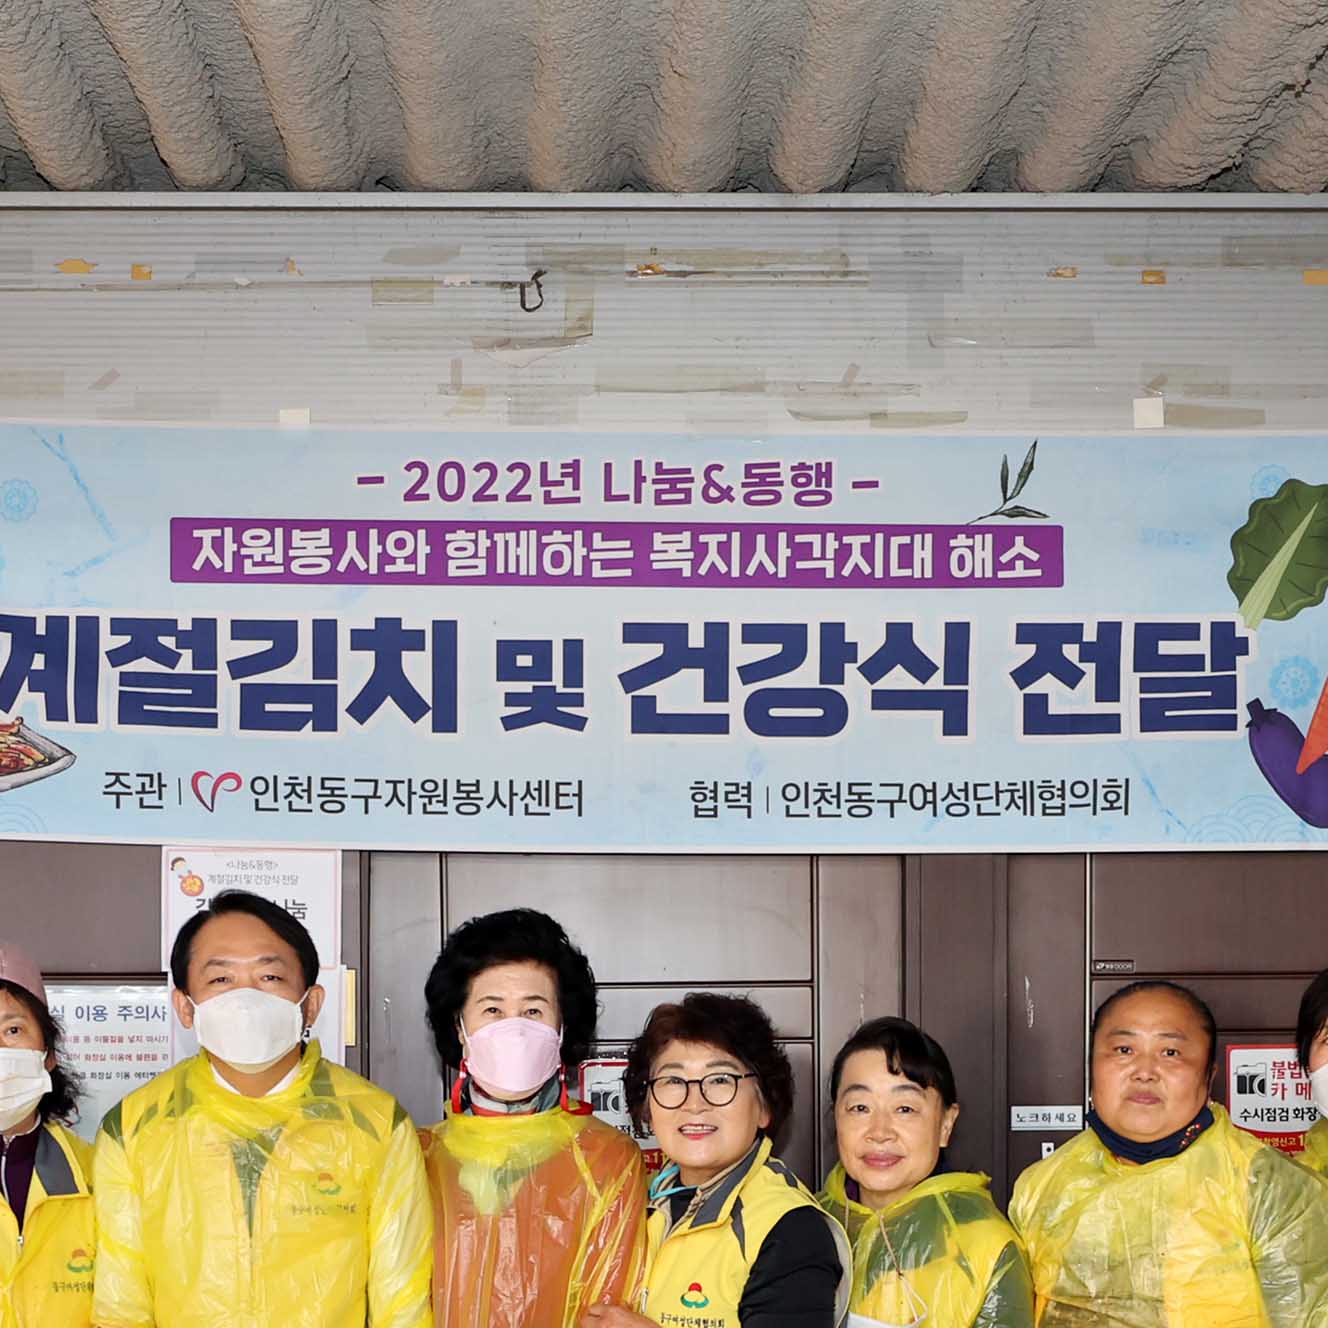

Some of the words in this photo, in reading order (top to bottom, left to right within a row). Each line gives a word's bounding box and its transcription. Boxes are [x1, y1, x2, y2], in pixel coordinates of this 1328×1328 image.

[402, 458, 583, 504] 2022년
[603, 461, 834, 508] 나눔&동행
[191, 526, 432, 577] 자원봉사와
[444, 527, 635, 579] 함께하는
[648, 531, 937, 582] 복지사각지대
[948, 532, 1043, 582] 해소
[494, 638, 589, 733] 및
[617, 620, 971, 738] 건강식
[1008, 619, 1250, 736] 전달
[102, 770, 168, 813] 주관
[248, 773, 586, 819] 인천동구자원봉사센터
[689, 780, 755, 820] 협력
[780, 778, 1132, 820] 인천동구여성단체협의회
[75, 1004, 109, 1022] 이용
[117, 1004, 168, 1022] 주의사
[1240, 1106, 1289, 1122] 수시점검
[1292, 1106, 1319, 1122] 화장
